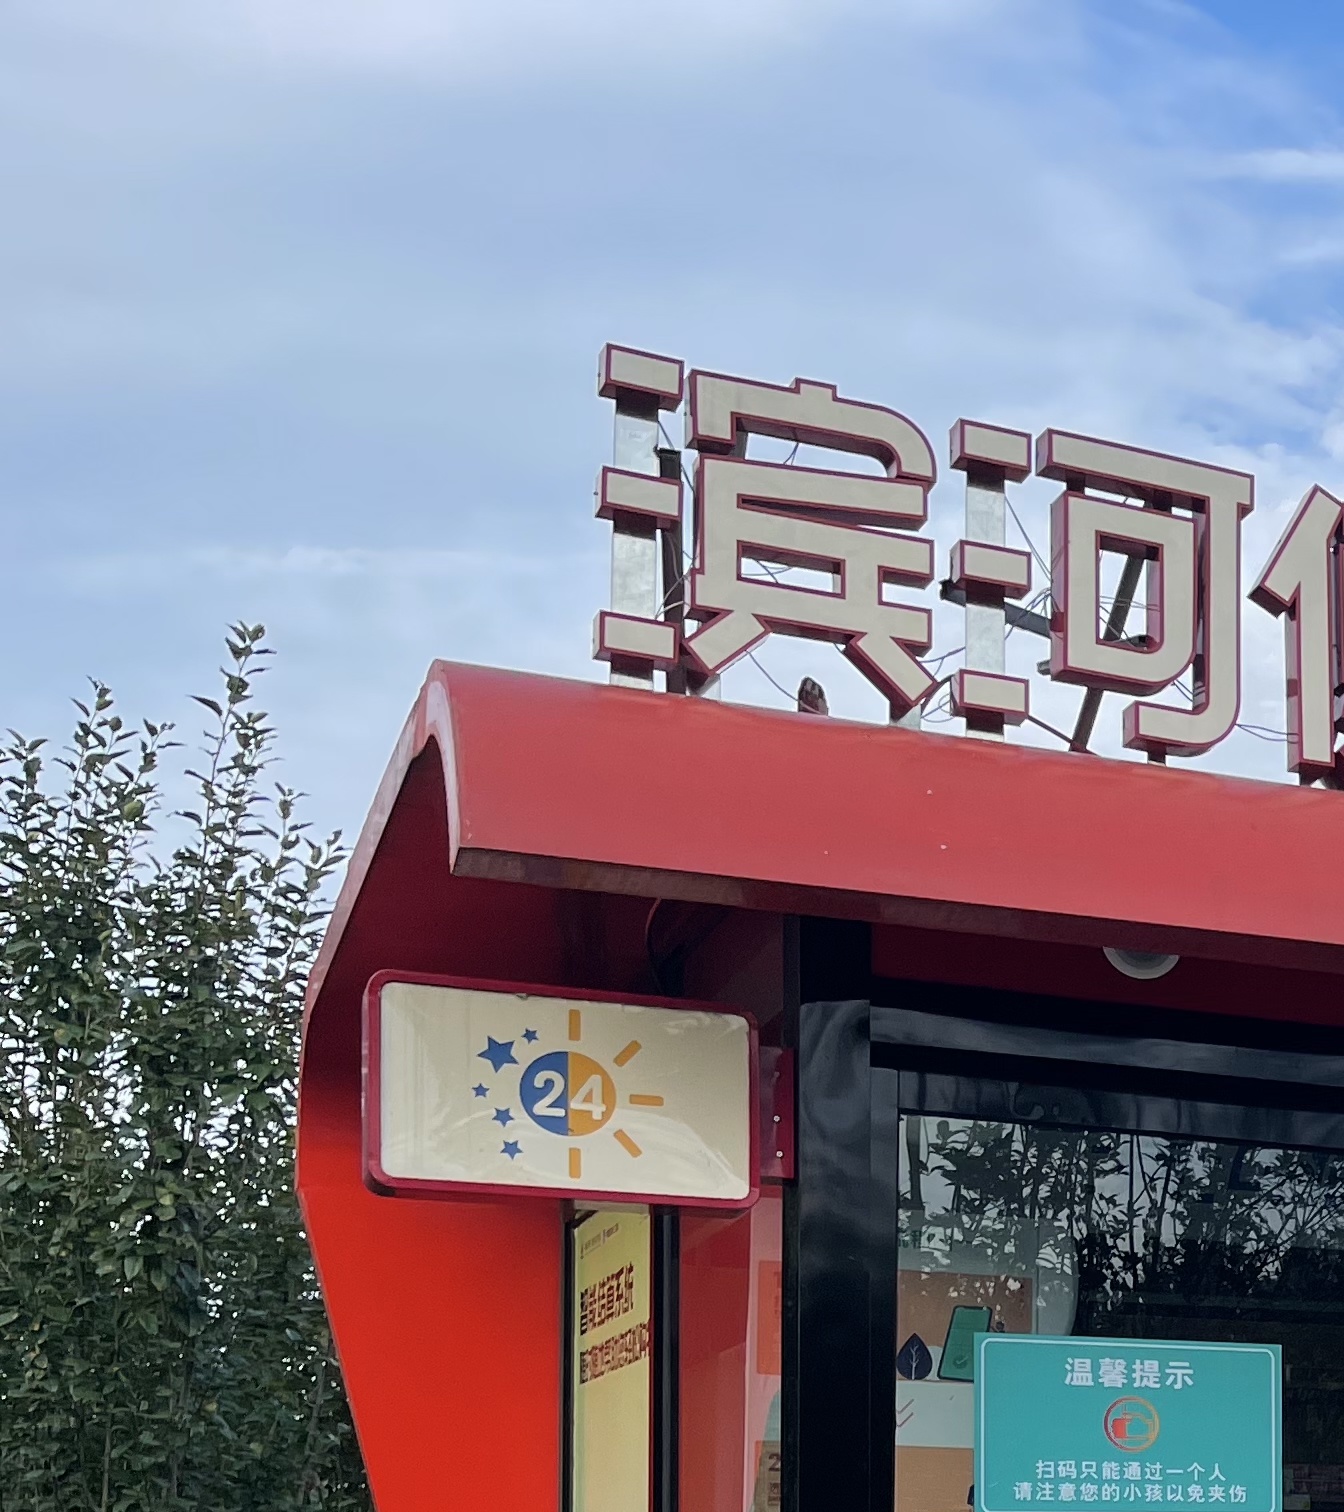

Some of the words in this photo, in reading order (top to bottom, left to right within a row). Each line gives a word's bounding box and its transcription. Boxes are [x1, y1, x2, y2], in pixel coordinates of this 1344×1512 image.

[532, 1070, 608, 1121] 24
[1064, 1357, 1195, 1390] 温馨提示
[1034, 1459, 1227, 1482] 扫码只能通过一个人
[1012, 1480, 1248, 1504] 请注意您的小孩以免夹伤
